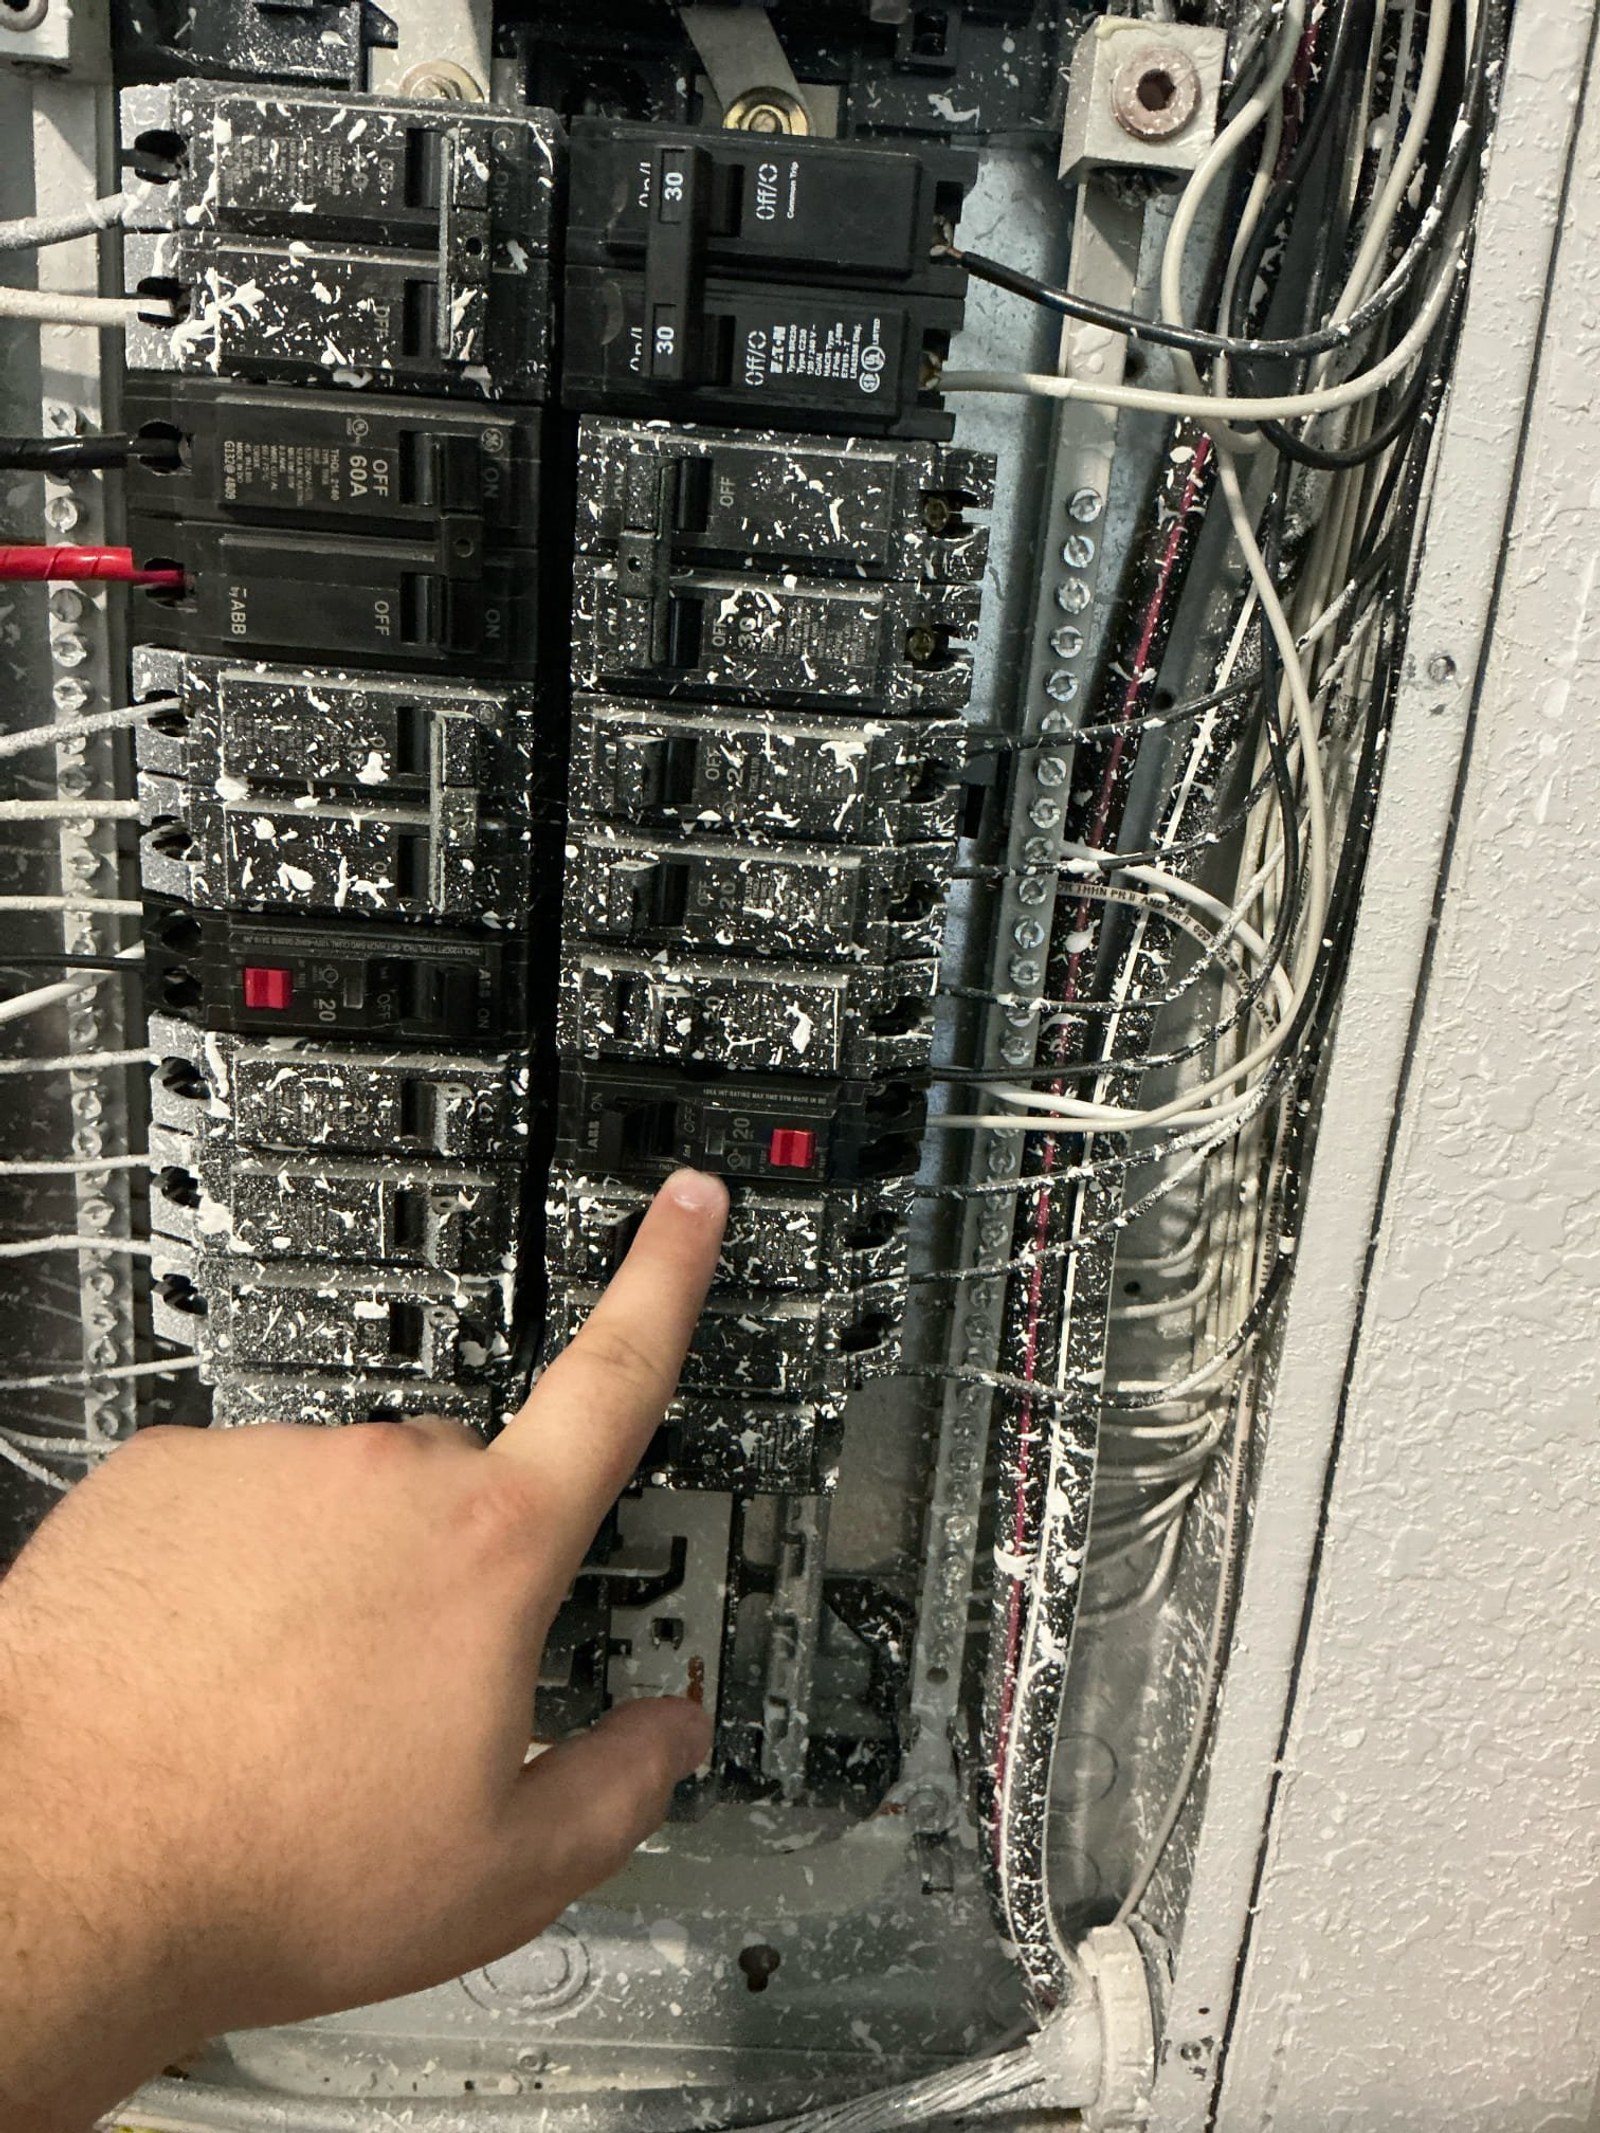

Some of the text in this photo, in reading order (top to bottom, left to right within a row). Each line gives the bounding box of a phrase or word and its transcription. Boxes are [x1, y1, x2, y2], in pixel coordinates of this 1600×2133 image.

[662, 172, 683, 202] 30
[787, 161, 799, 219] Common Trip
[656, 326, 674, 355] 30
[787, 353, 796, 373] Type
[797, 353, 806, 374] Type
[349, 454, 369, 497] 60A
[372, 459, 389, 497] OFF
[484, 467, 498, 499] ON
[720, 476, 736, 508] OFF
[231, 599, 247, 635] ABB
[374, 601, 390, 636] OFF
[484, 609, 500, 639] ON
[738, 617, 757, 648] 30
[719, 881, 736, 910] 20
[1076, 884, 1107, 896] THHN
[1110, 890, 1126, 900] PR
[1141, 896, 1165, 909] AND
[318, 998, 336, 1022] 20
[377, 993, 391, 1019] OFF
[478, 1008, 489, 1029] ON
[591, 1092, 603, 1112] ON
[588, 1120, 600, 1148] ABB
[683, 1107, 697, 1133] OFF
[732, 1117, 751, 1139] 20
